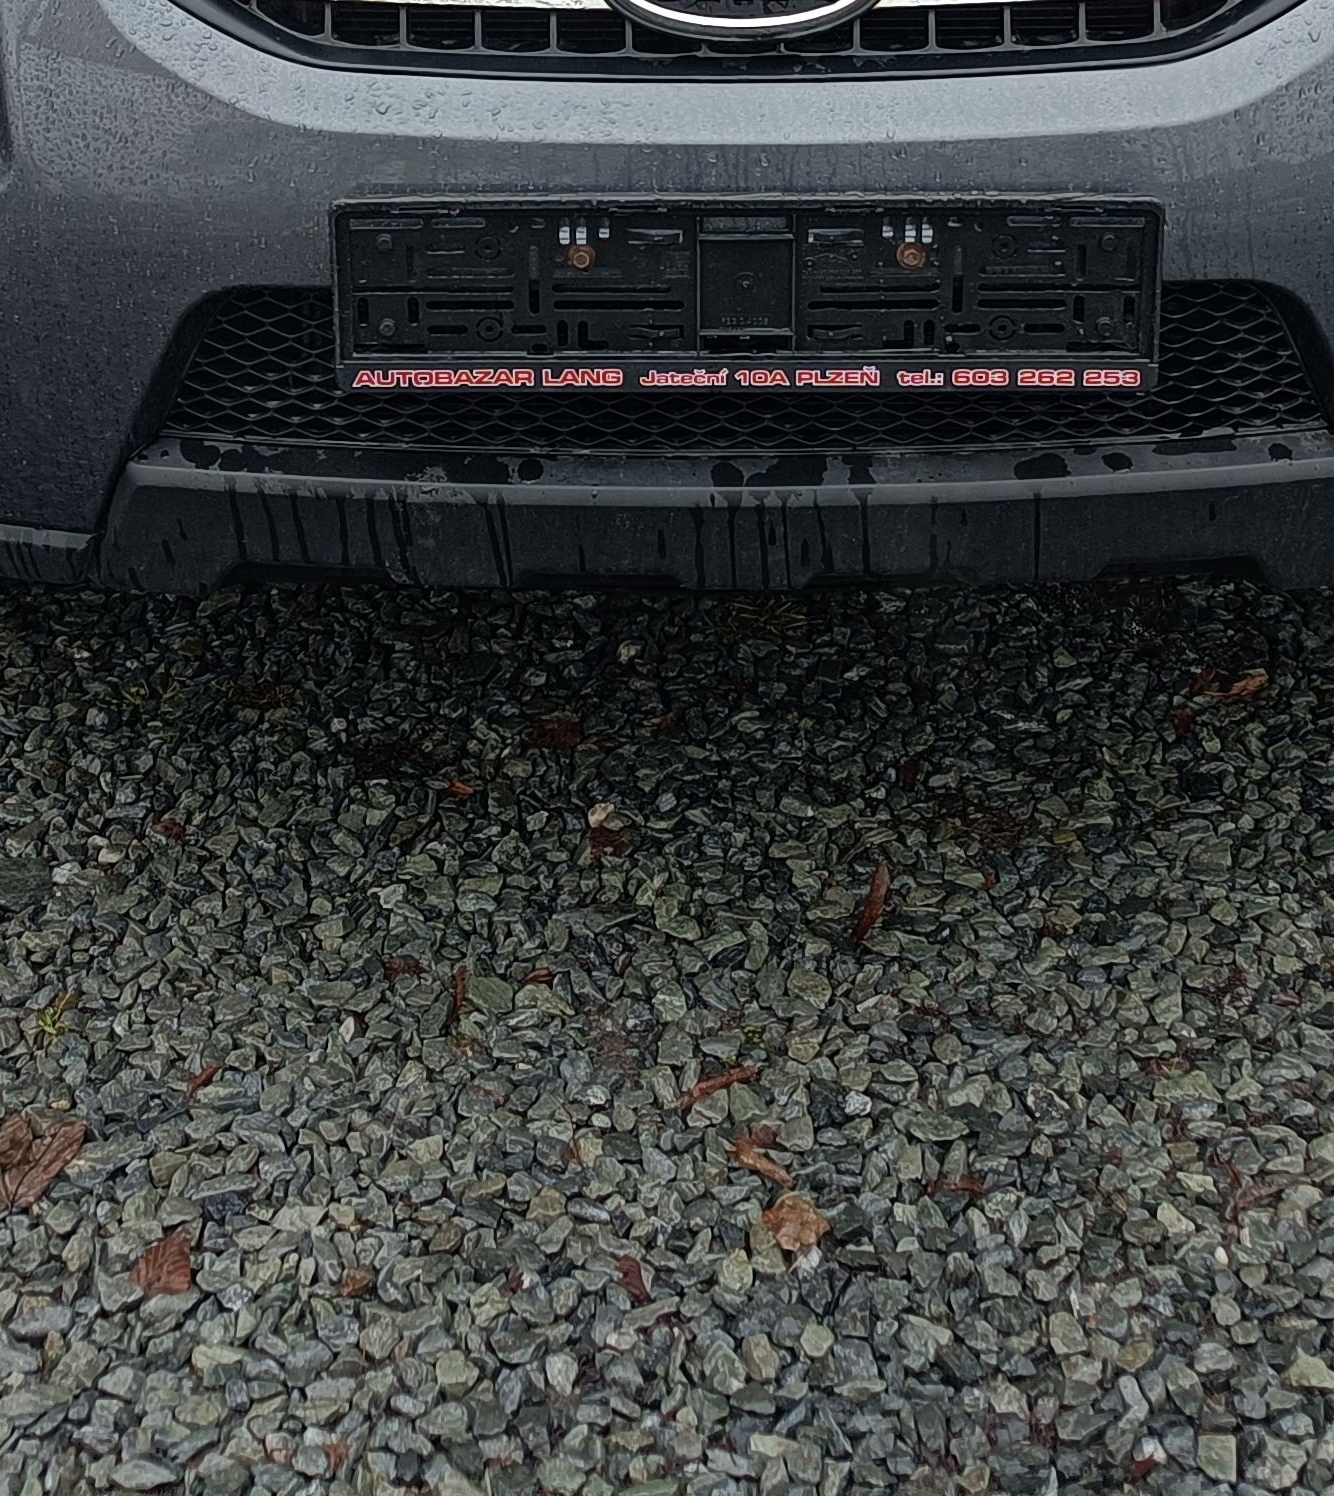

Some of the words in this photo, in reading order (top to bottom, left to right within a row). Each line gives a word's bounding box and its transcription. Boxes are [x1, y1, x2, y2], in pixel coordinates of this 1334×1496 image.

[352, 369, 534, 387] AUTOBAZAR
[542, 368, 623, 386] LANG
[639, 368, 729, 386] Jateční
[734, 369, 790, 386] 10A
[795, 366, 880, 386] PLZEŇ
[897, 369, 943, 386] tel.:
[952, 369, 1009, 386] 603
[1017, 369, 1075, 386] 262
[1083, 370, 1140, 386] 253
